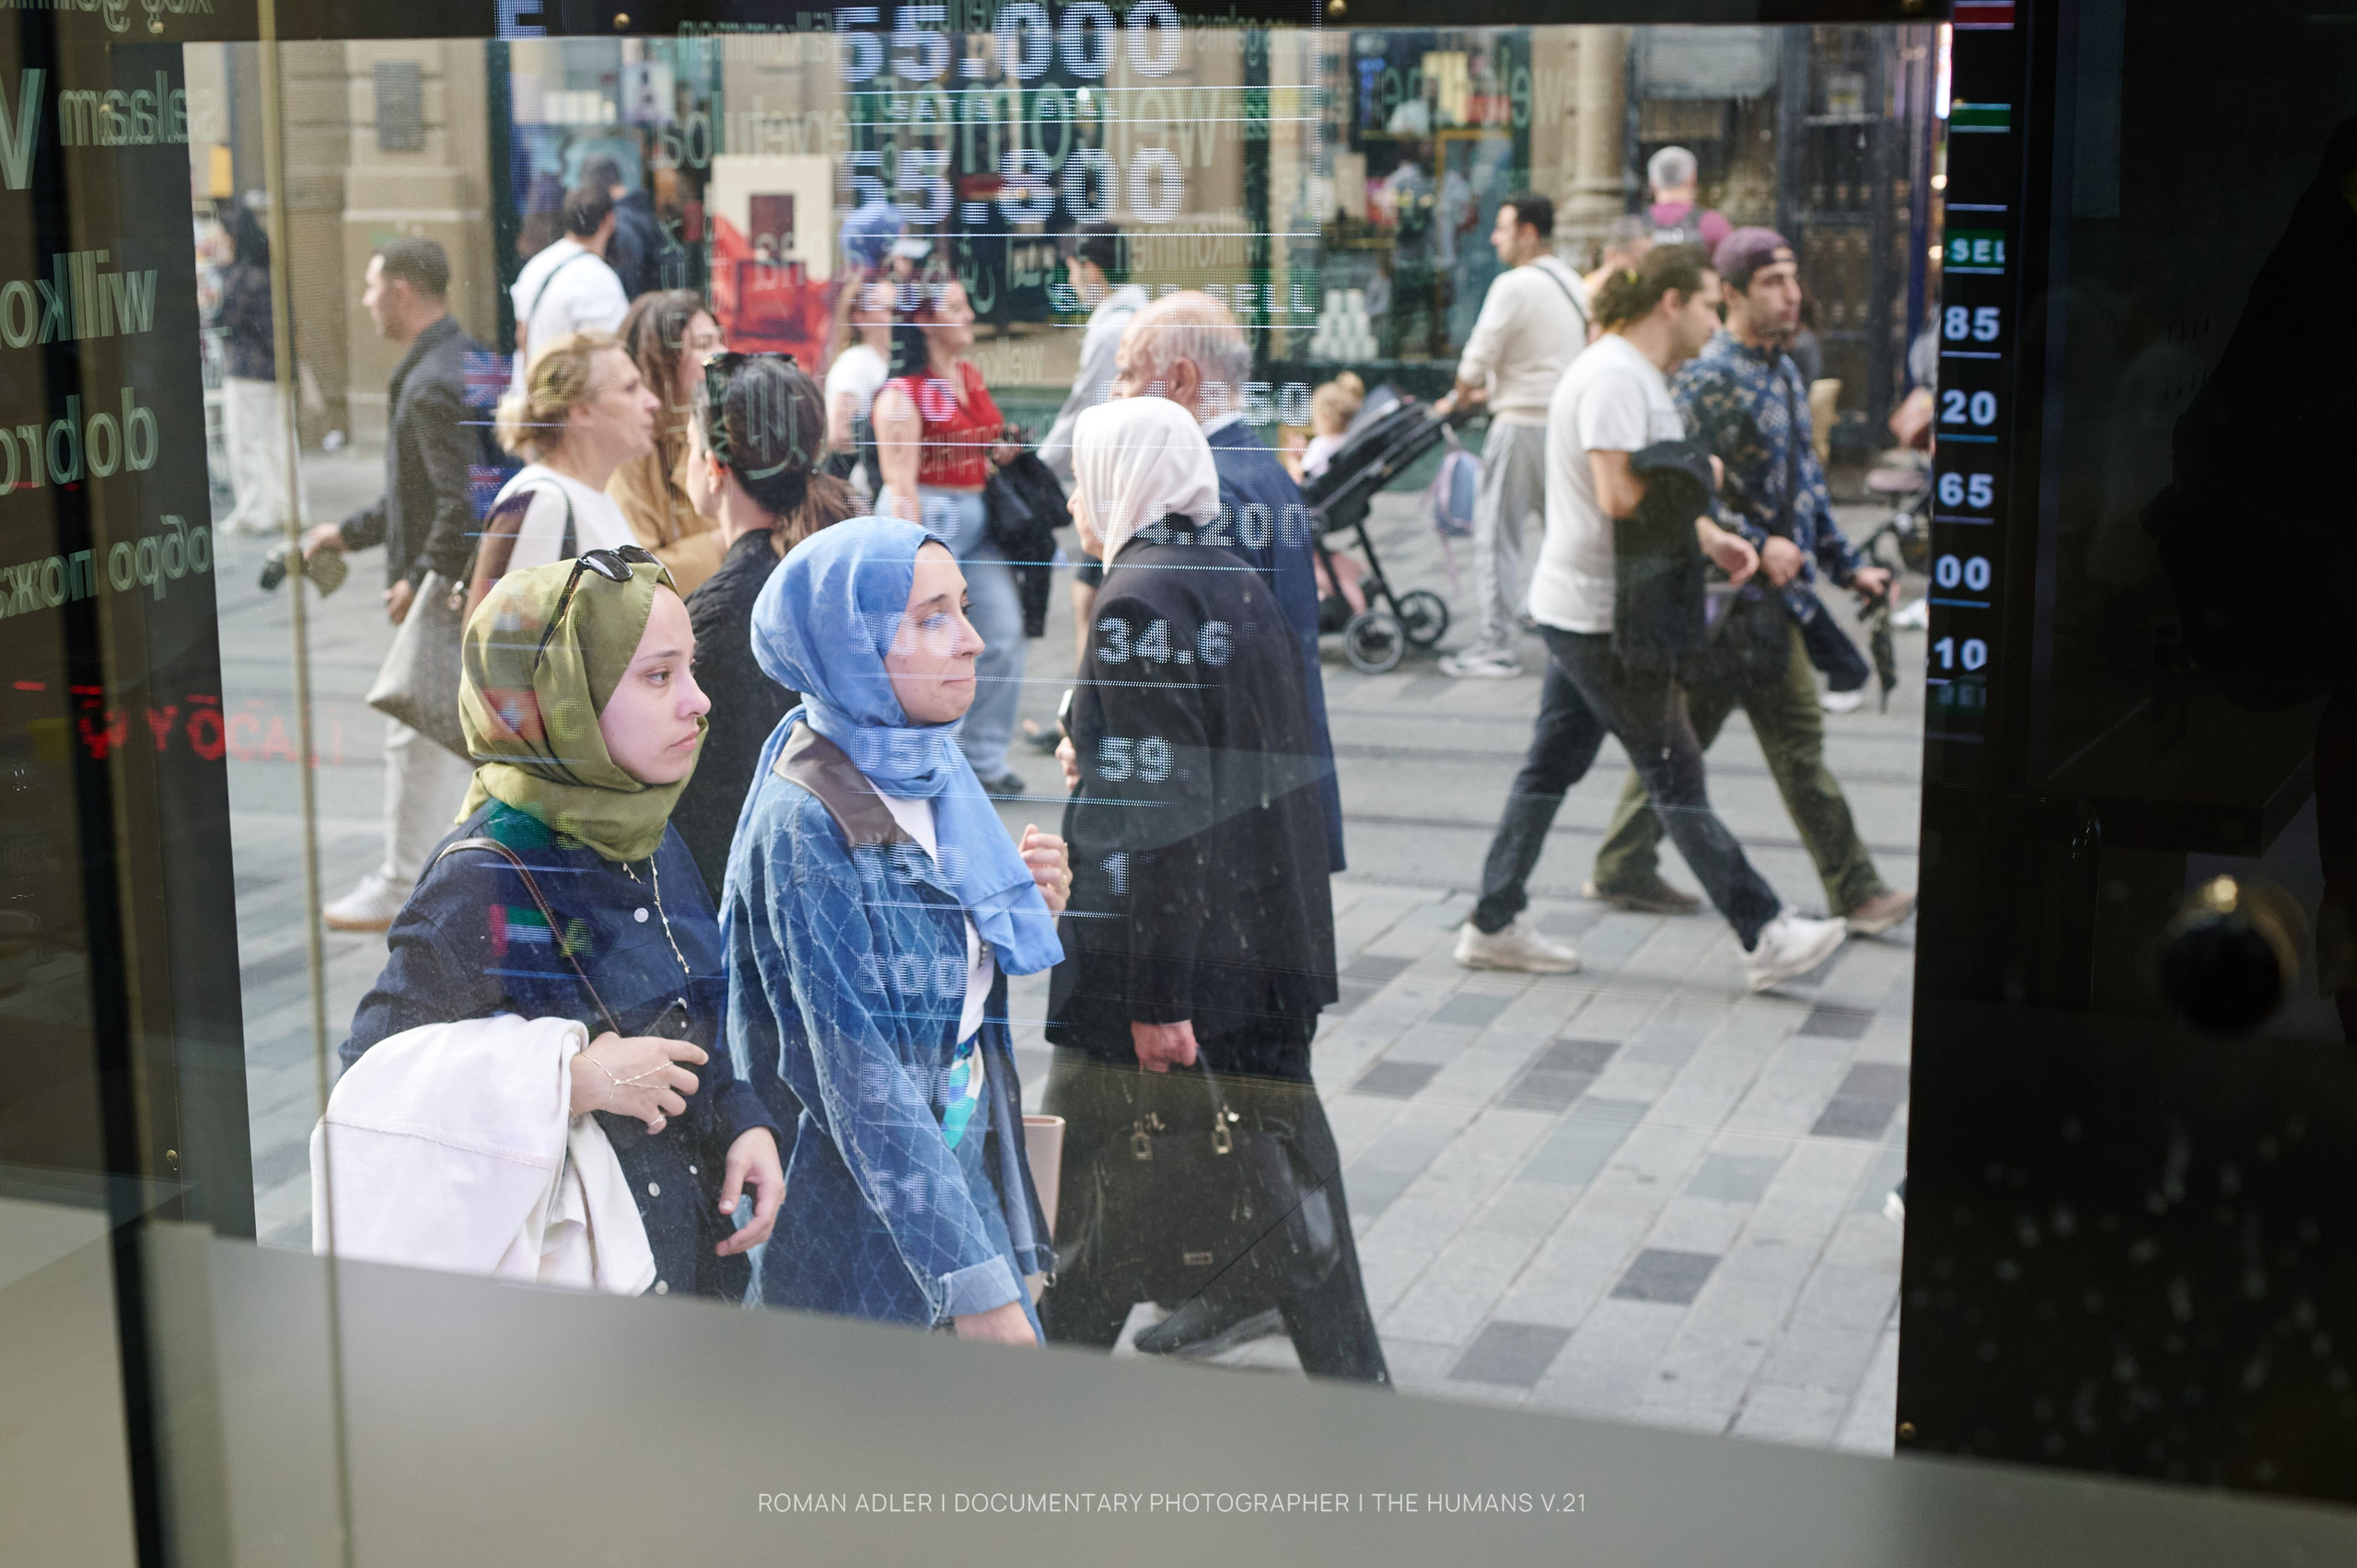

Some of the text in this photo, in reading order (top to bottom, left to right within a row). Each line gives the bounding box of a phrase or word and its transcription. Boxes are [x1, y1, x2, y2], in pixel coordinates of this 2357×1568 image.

[831, 0, 1184, 82] 55.000
[833, 147, 1186, 226] 55.800
[1944, 305, 2001, 342] 85
[1940, 389, 1998, 425] 20
[1938, 471, 1994, 509] 65
[1936, 554, 1991, 591] 00
[1095, 617, 1256, 667] 34.6
[1933, 637, 1988, 670] 10
